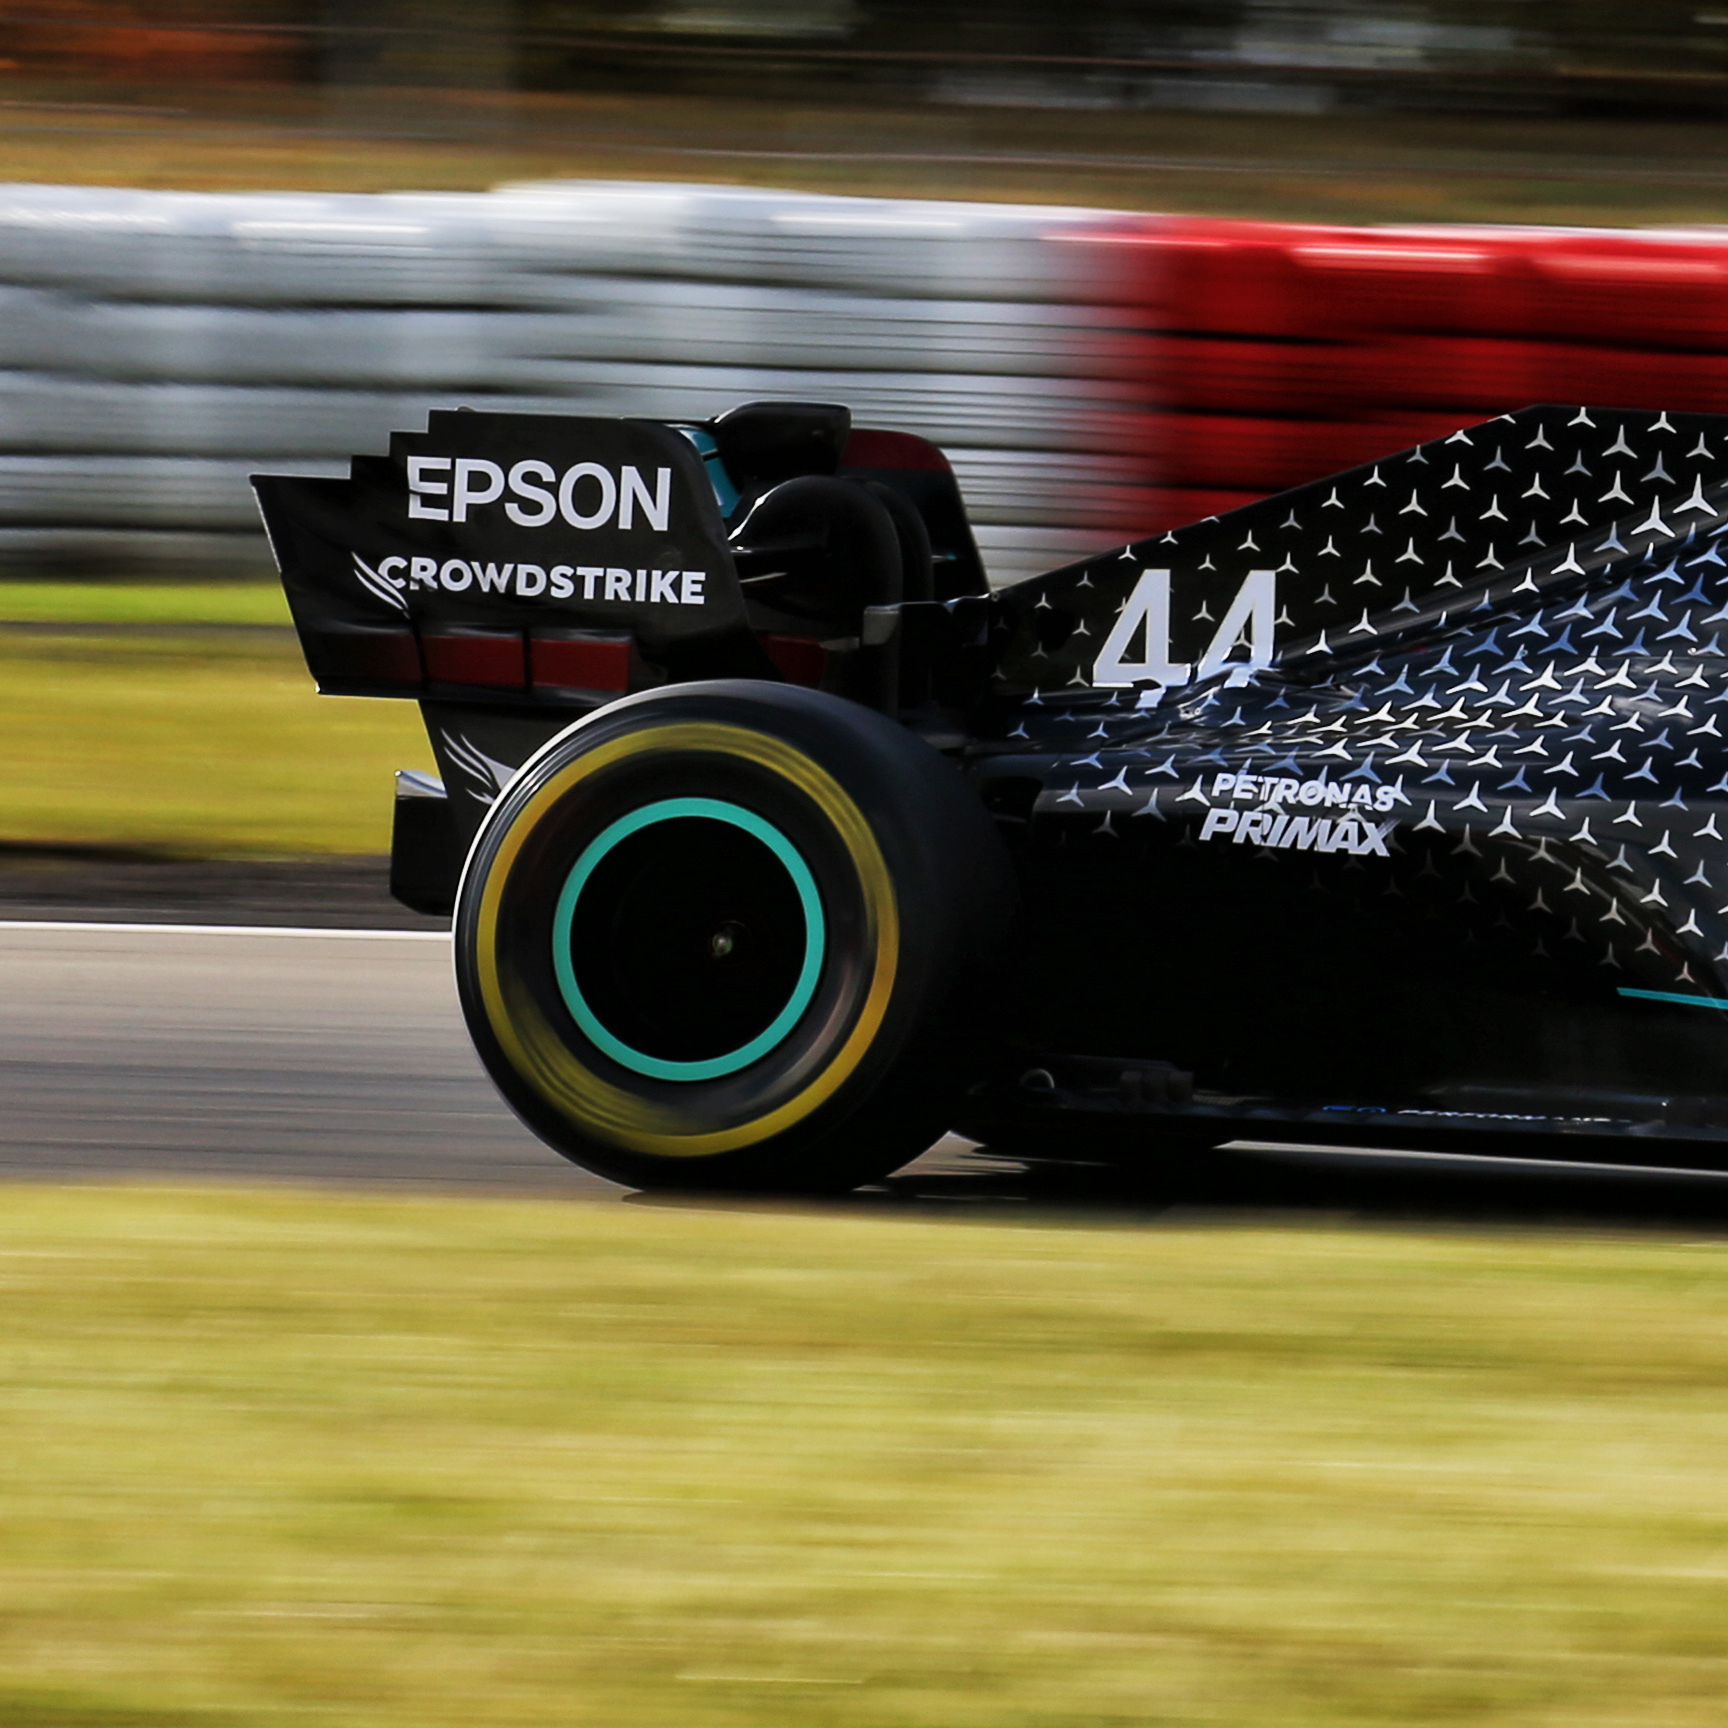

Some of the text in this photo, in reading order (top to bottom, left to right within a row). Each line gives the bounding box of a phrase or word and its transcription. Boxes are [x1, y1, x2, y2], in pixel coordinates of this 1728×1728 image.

[407, 456, 671, 531] EPSON
[379, 556, 706, 604] CROWDSTRIKE
[1092, 569, 1277, 708] 44
[1211, 774, 1395, 812] PETRONAS
[1199, 809, 1396, 856] PRIMAX
